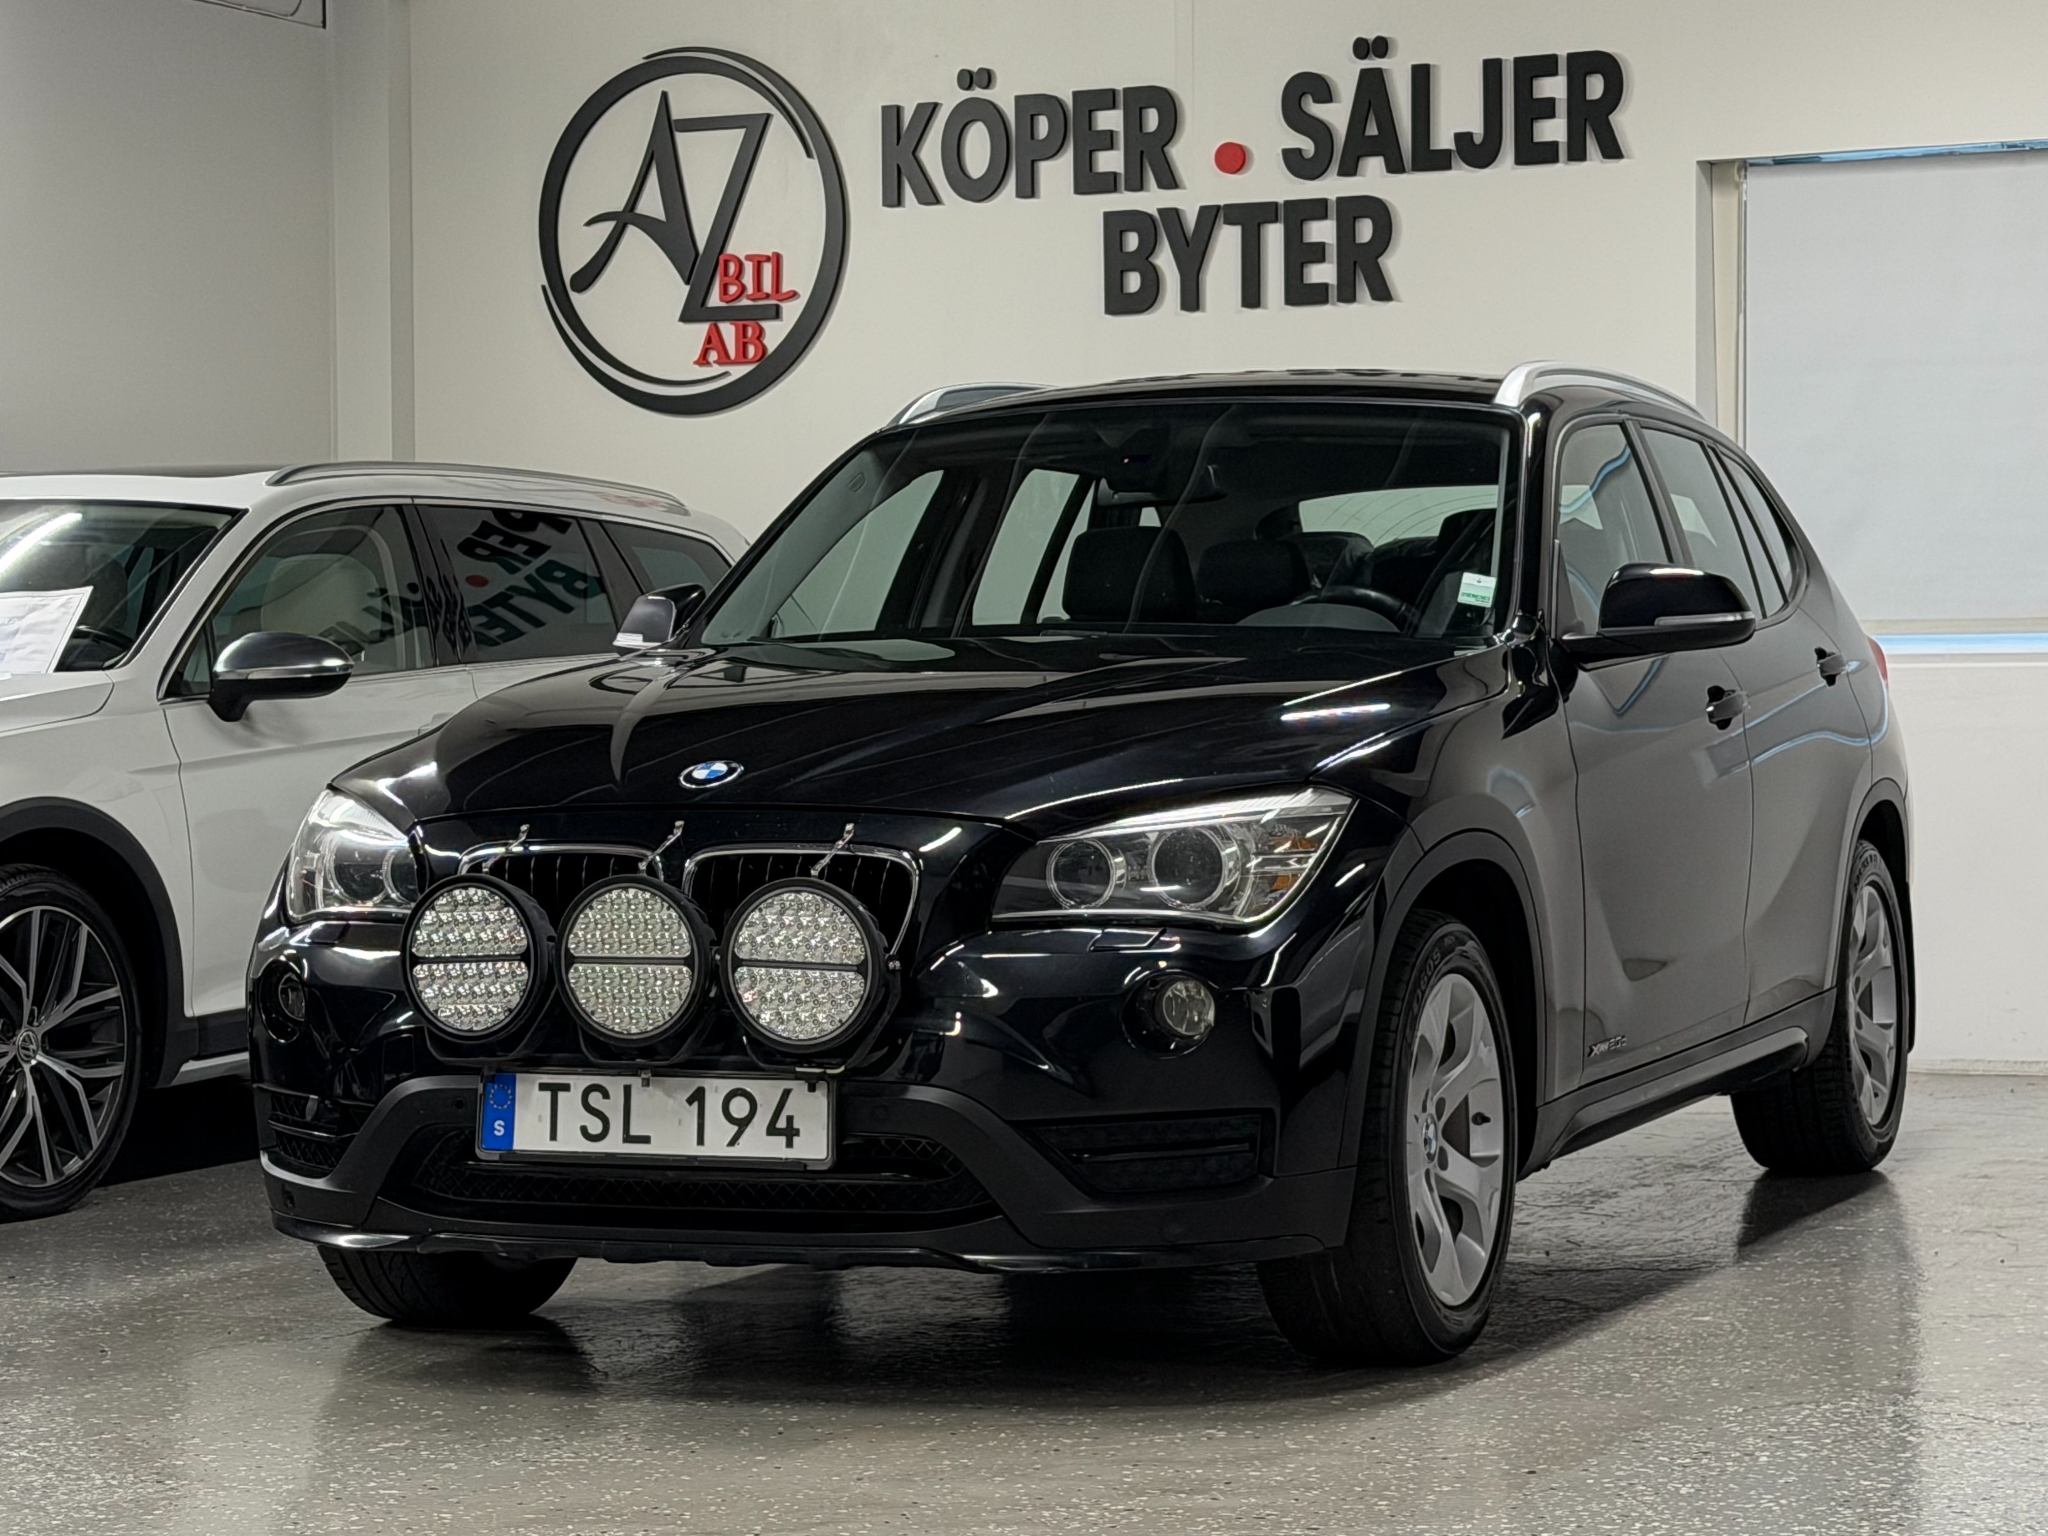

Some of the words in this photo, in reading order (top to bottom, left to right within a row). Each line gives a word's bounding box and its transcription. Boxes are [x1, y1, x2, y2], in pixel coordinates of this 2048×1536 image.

[881, 67, 1180, 208] KÖPER
[1281, 35, 1625, 182] SÄLJER
[569, 89, 774, 324] AZ
[718, 251, 799, 304] BIL
[1103, 194, 1395, 316] BYTER
[693, 320, 767, 366] AB
[493, 1120, 505, 1136] S
[537, 1081, 652, 1145] TSL
[685, 1085, 801, 1149] 194
